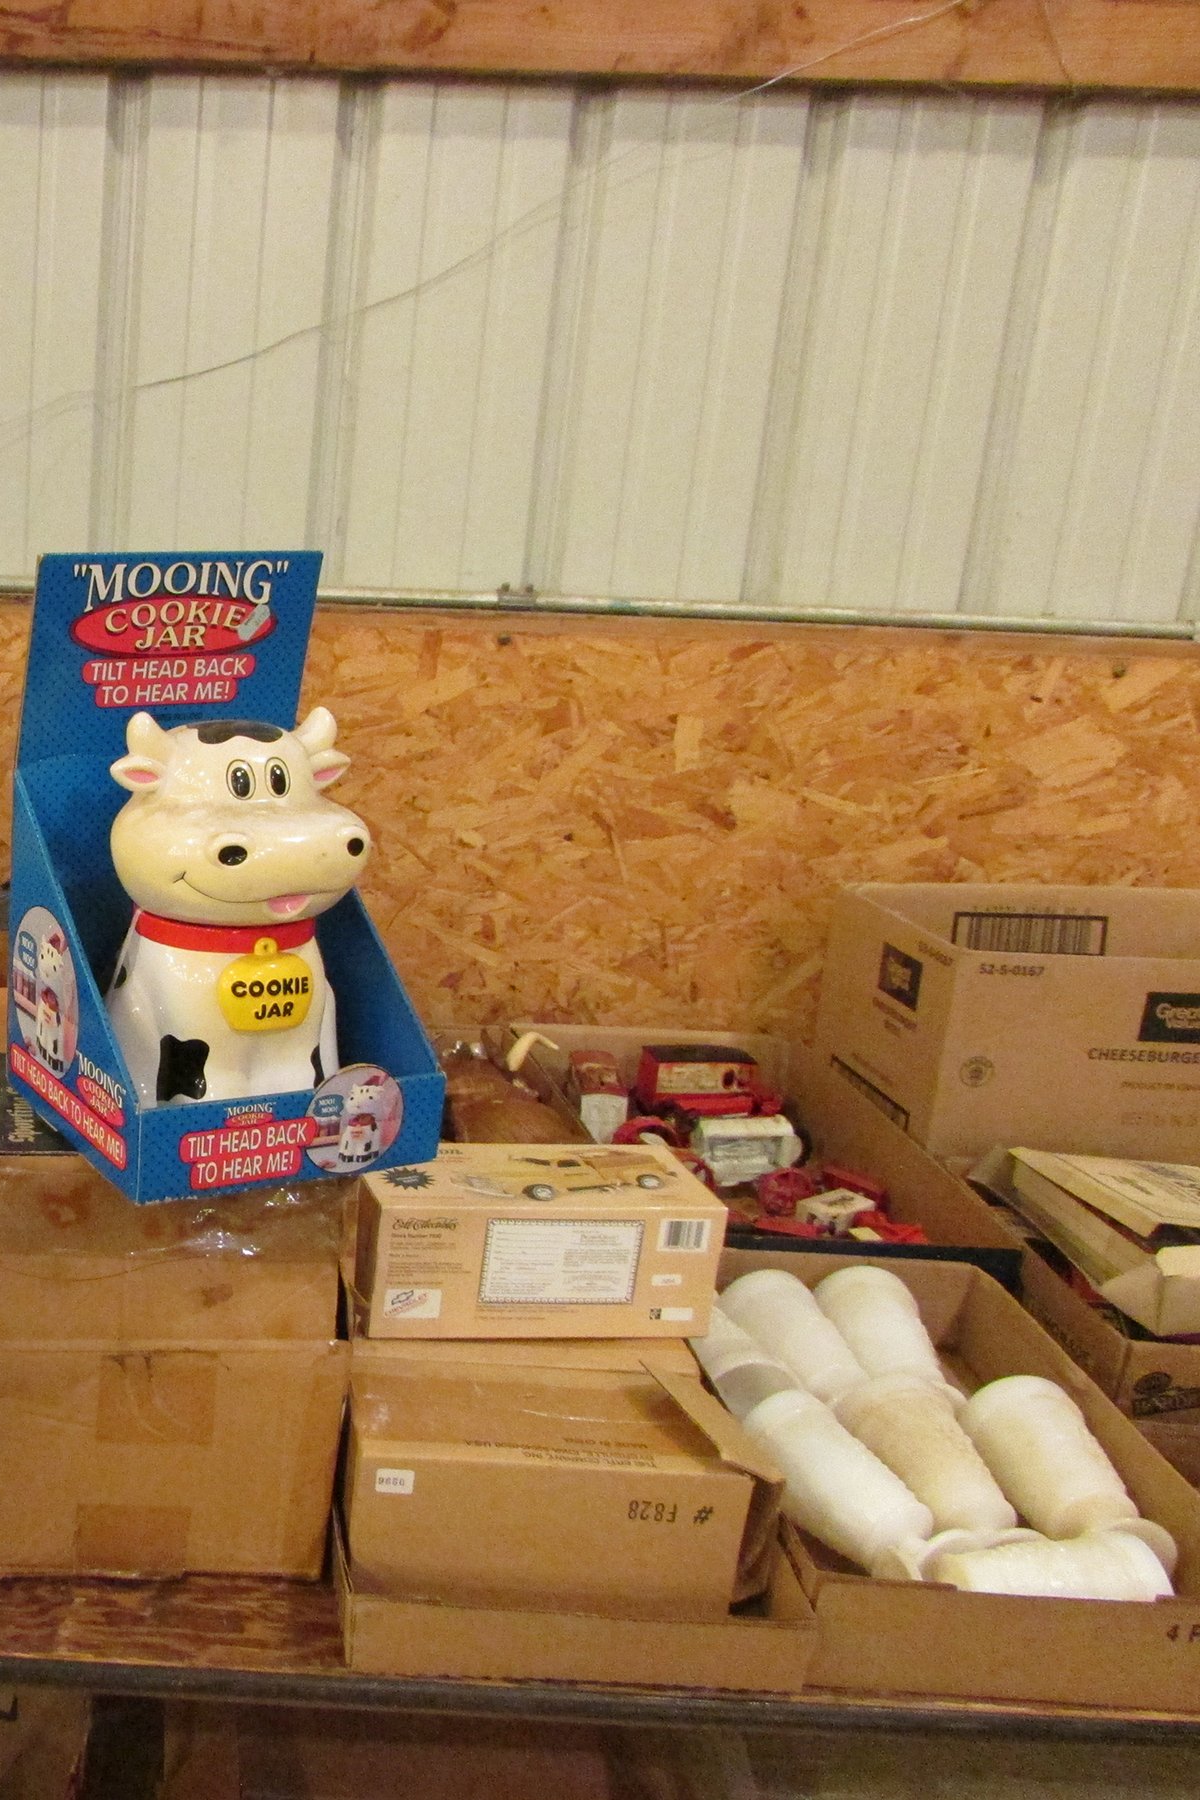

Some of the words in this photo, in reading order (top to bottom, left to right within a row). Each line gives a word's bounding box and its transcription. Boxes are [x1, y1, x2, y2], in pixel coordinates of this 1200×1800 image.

[73, 560, 290, 612] "MOOING"
[105, 600, 246, 634] COOKIE
[135, 625, 207, 650] JAR
[90, 660, 126, 681] TILT
[131, 658, 188, 680] HEAD
[194, 656, 247, 678] BACK
[101, 684, 129, 705] TO
[135, 682, 187, 703] HEAR
[194, 680, 230, 701] ME!
[230, 976, 310, 998] COOKIE
[254, 1001, 295, 1020] JAR
[1088, 1047, 1200, 1064] CHEESEBURGE
[12, 1049, 26, 1074] TILT
[27, 1061, 47, 1093] HEAD
[48, 1081, 69, 1114] BACK
[70, 1100, 82, 1125] TO
[82, 1112, 105, 1148] HEAR
[106, 1134, 124, 1164] ME!
[188, 1134, 216, 1159] TILT
[219, 1128, 262, 1154] HEAD
[266, 1121, 308, 1147] BACK
[196, 1161, 218, 1184] TO
[222, 1155, 263, 1181] HEAR
[266, 1150, 295, 1174] ME!
[627, 1499, 678, 1524] F828
